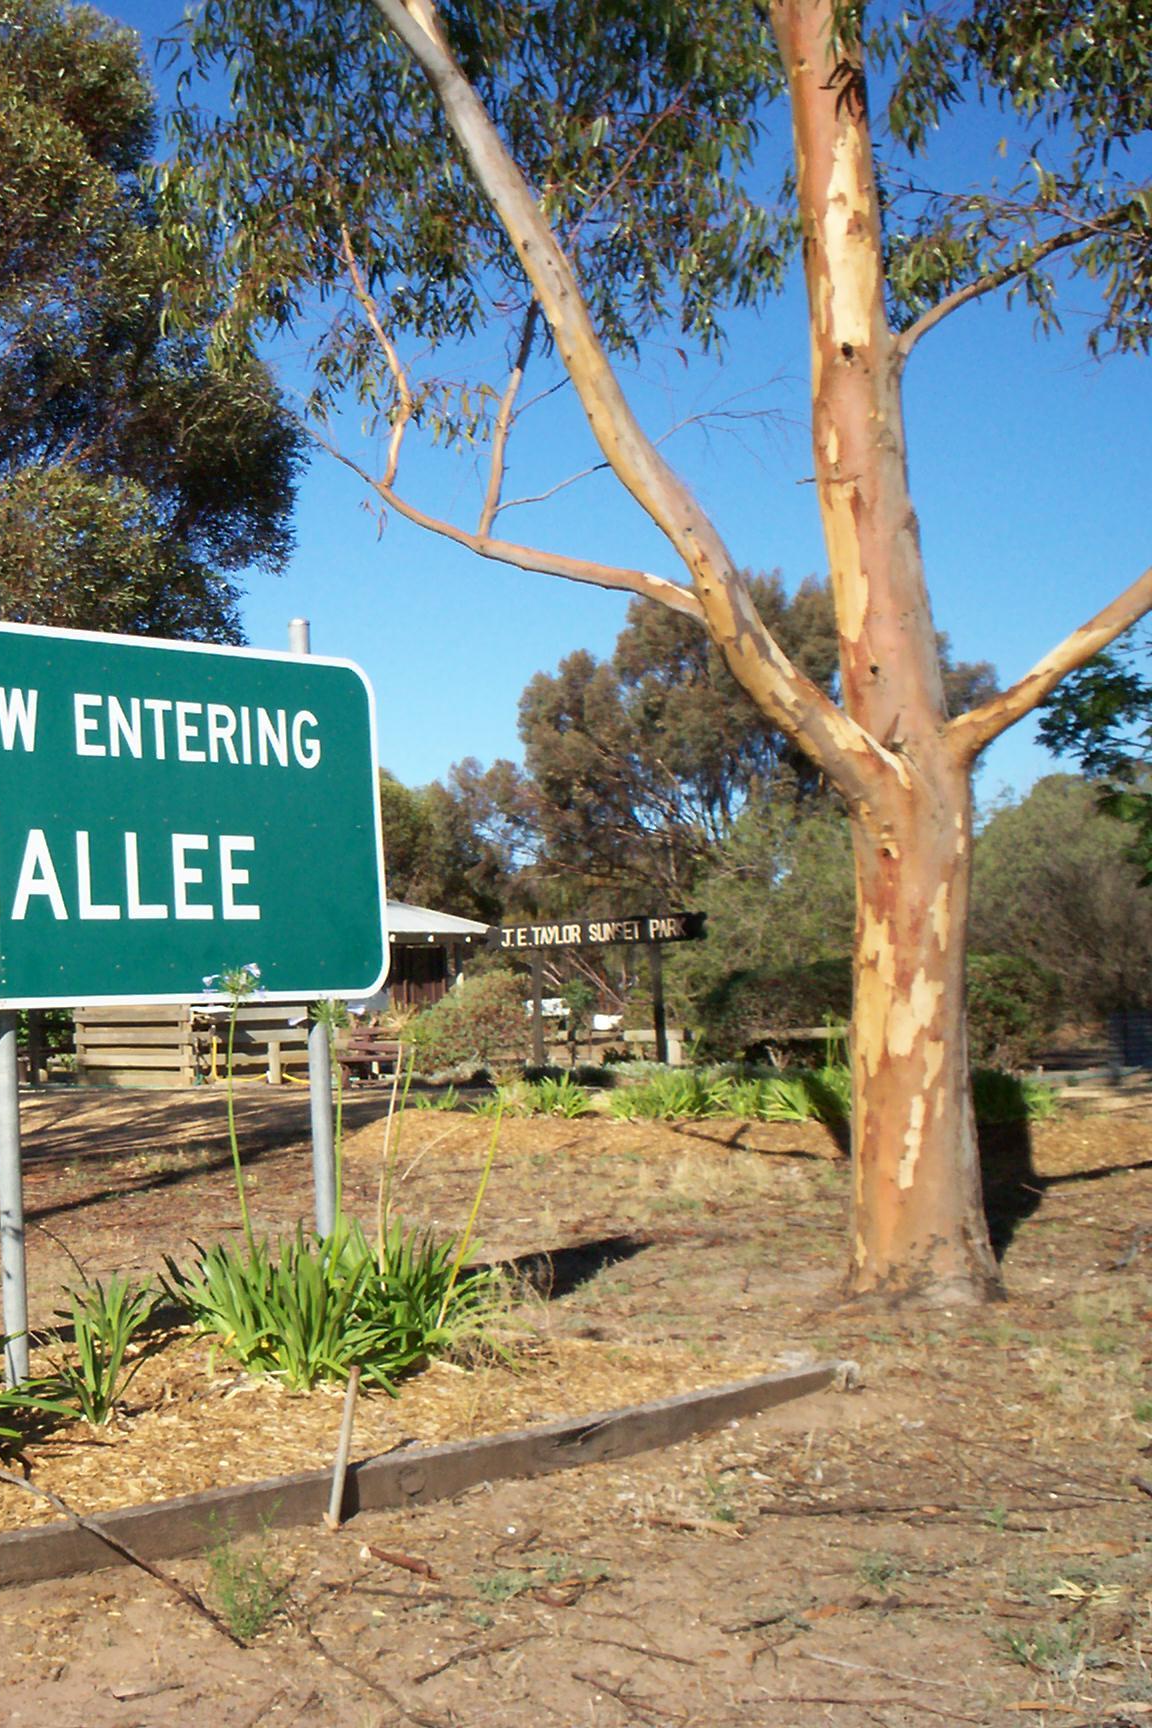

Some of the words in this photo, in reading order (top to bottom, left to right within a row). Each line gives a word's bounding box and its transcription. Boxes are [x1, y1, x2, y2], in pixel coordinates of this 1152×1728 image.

[73, 693, 322, 769] ENTERING
[588, 920, 641, 942] SUNSET
[649, 917, 688, 939] PARK
